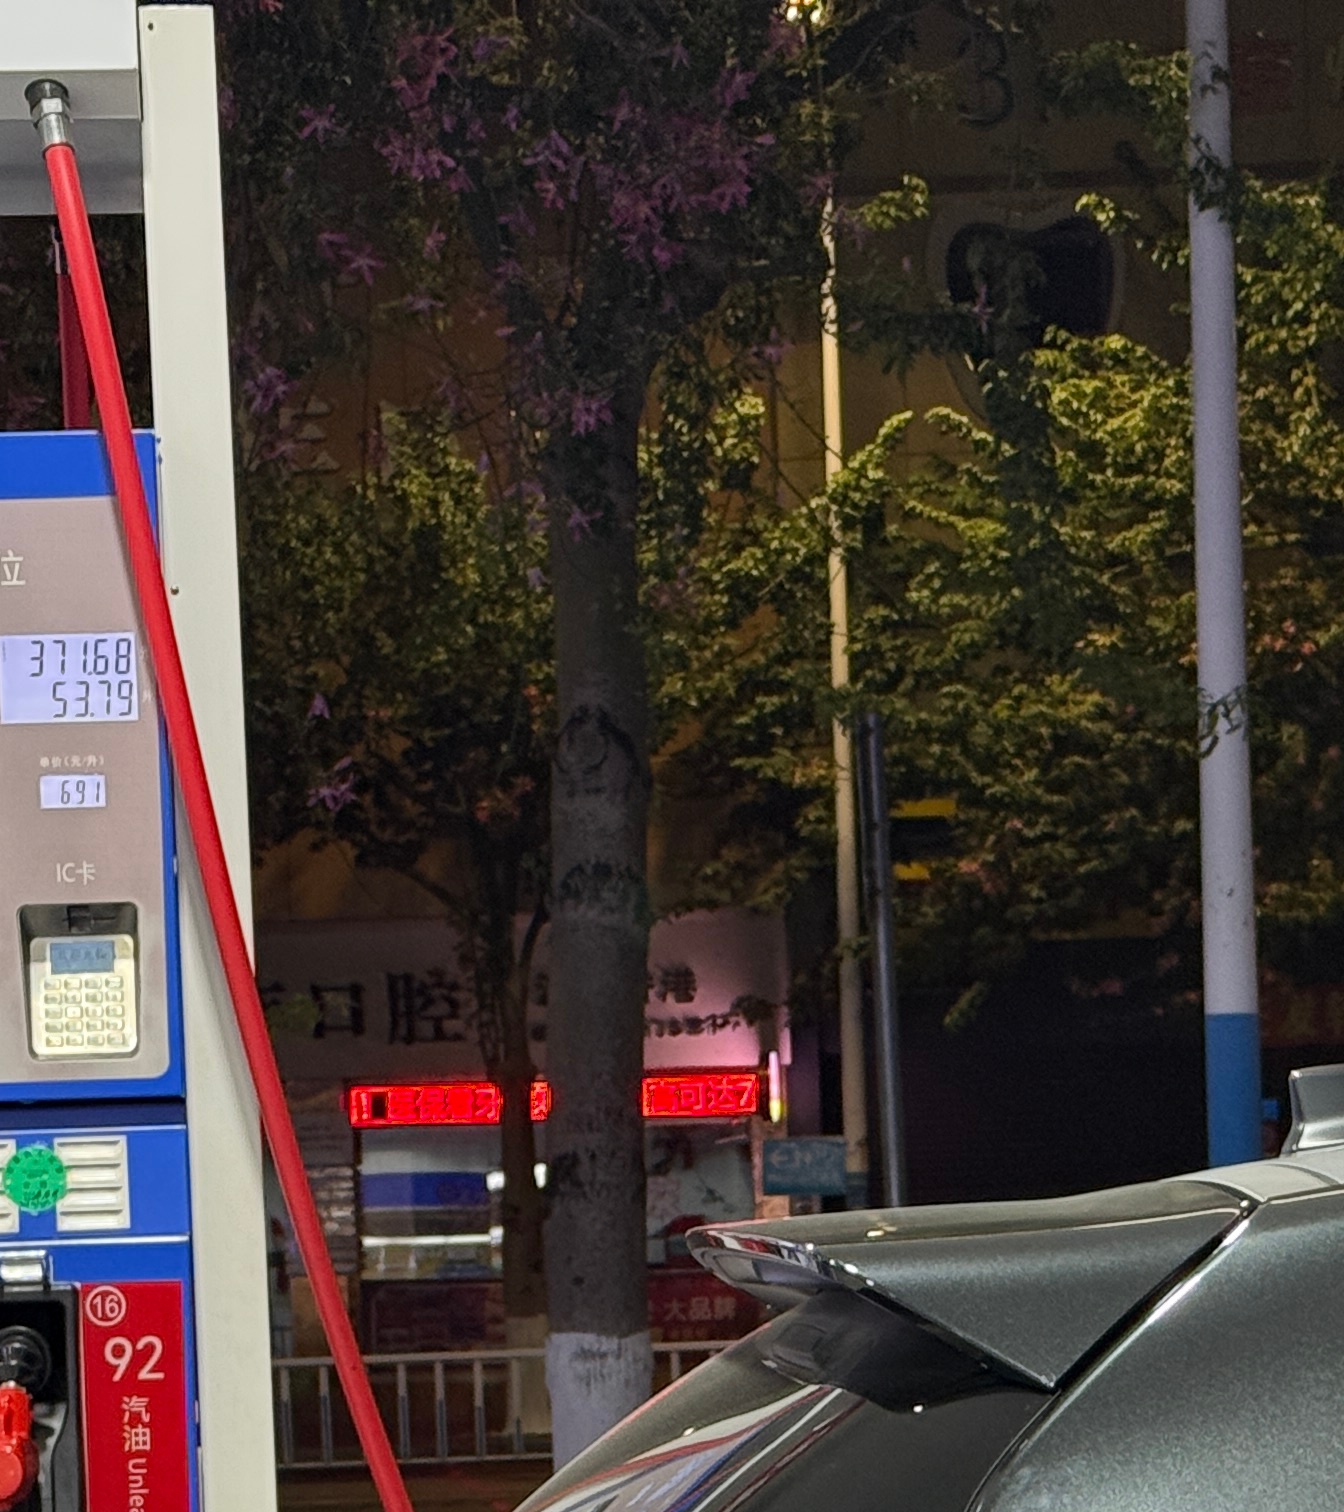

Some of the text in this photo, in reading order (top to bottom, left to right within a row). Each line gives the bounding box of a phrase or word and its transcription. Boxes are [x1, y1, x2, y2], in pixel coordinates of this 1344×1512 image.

[29, 637, 132, 678] 371.68
[52, 679, 134, 718] 53.79
[57, 861, 96, 885] IC卡
[103, 1335, 165, 1382] 92
[122, 1395, 151, 1453] 汽油
